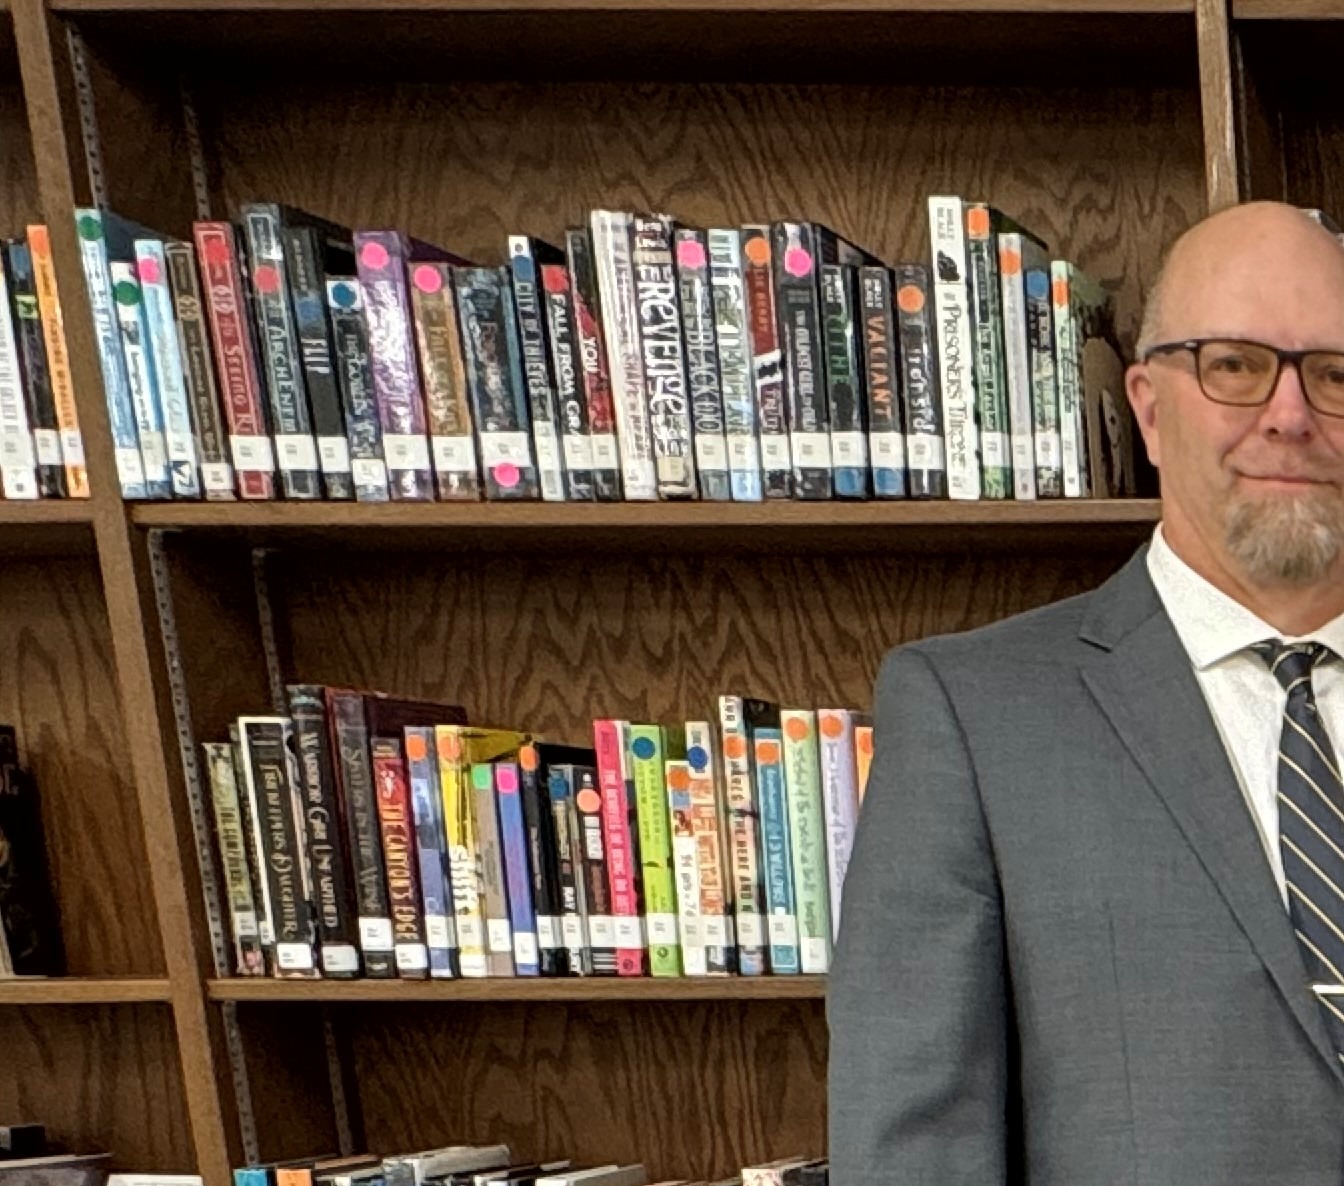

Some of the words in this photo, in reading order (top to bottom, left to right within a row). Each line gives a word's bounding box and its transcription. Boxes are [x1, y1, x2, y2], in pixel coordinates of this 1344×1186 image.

[301, 339, 329, 374] FLIP
[551, 294, 569, 337] FALL
[560, 342, 574, 394] FROM
[568, 400, 581, 438] GRA
[583, 337, 598, 374] YOU
[867, 315, 892, 419] VALIANT
[270, 326, 296, 432] ARCHENEM
[384, 804, 404, 827] THE
[386, 834, 413, 899] CANYON'S
[563, 887, 575, 909] RAY
[394, 905, 418, 940] EDGE
